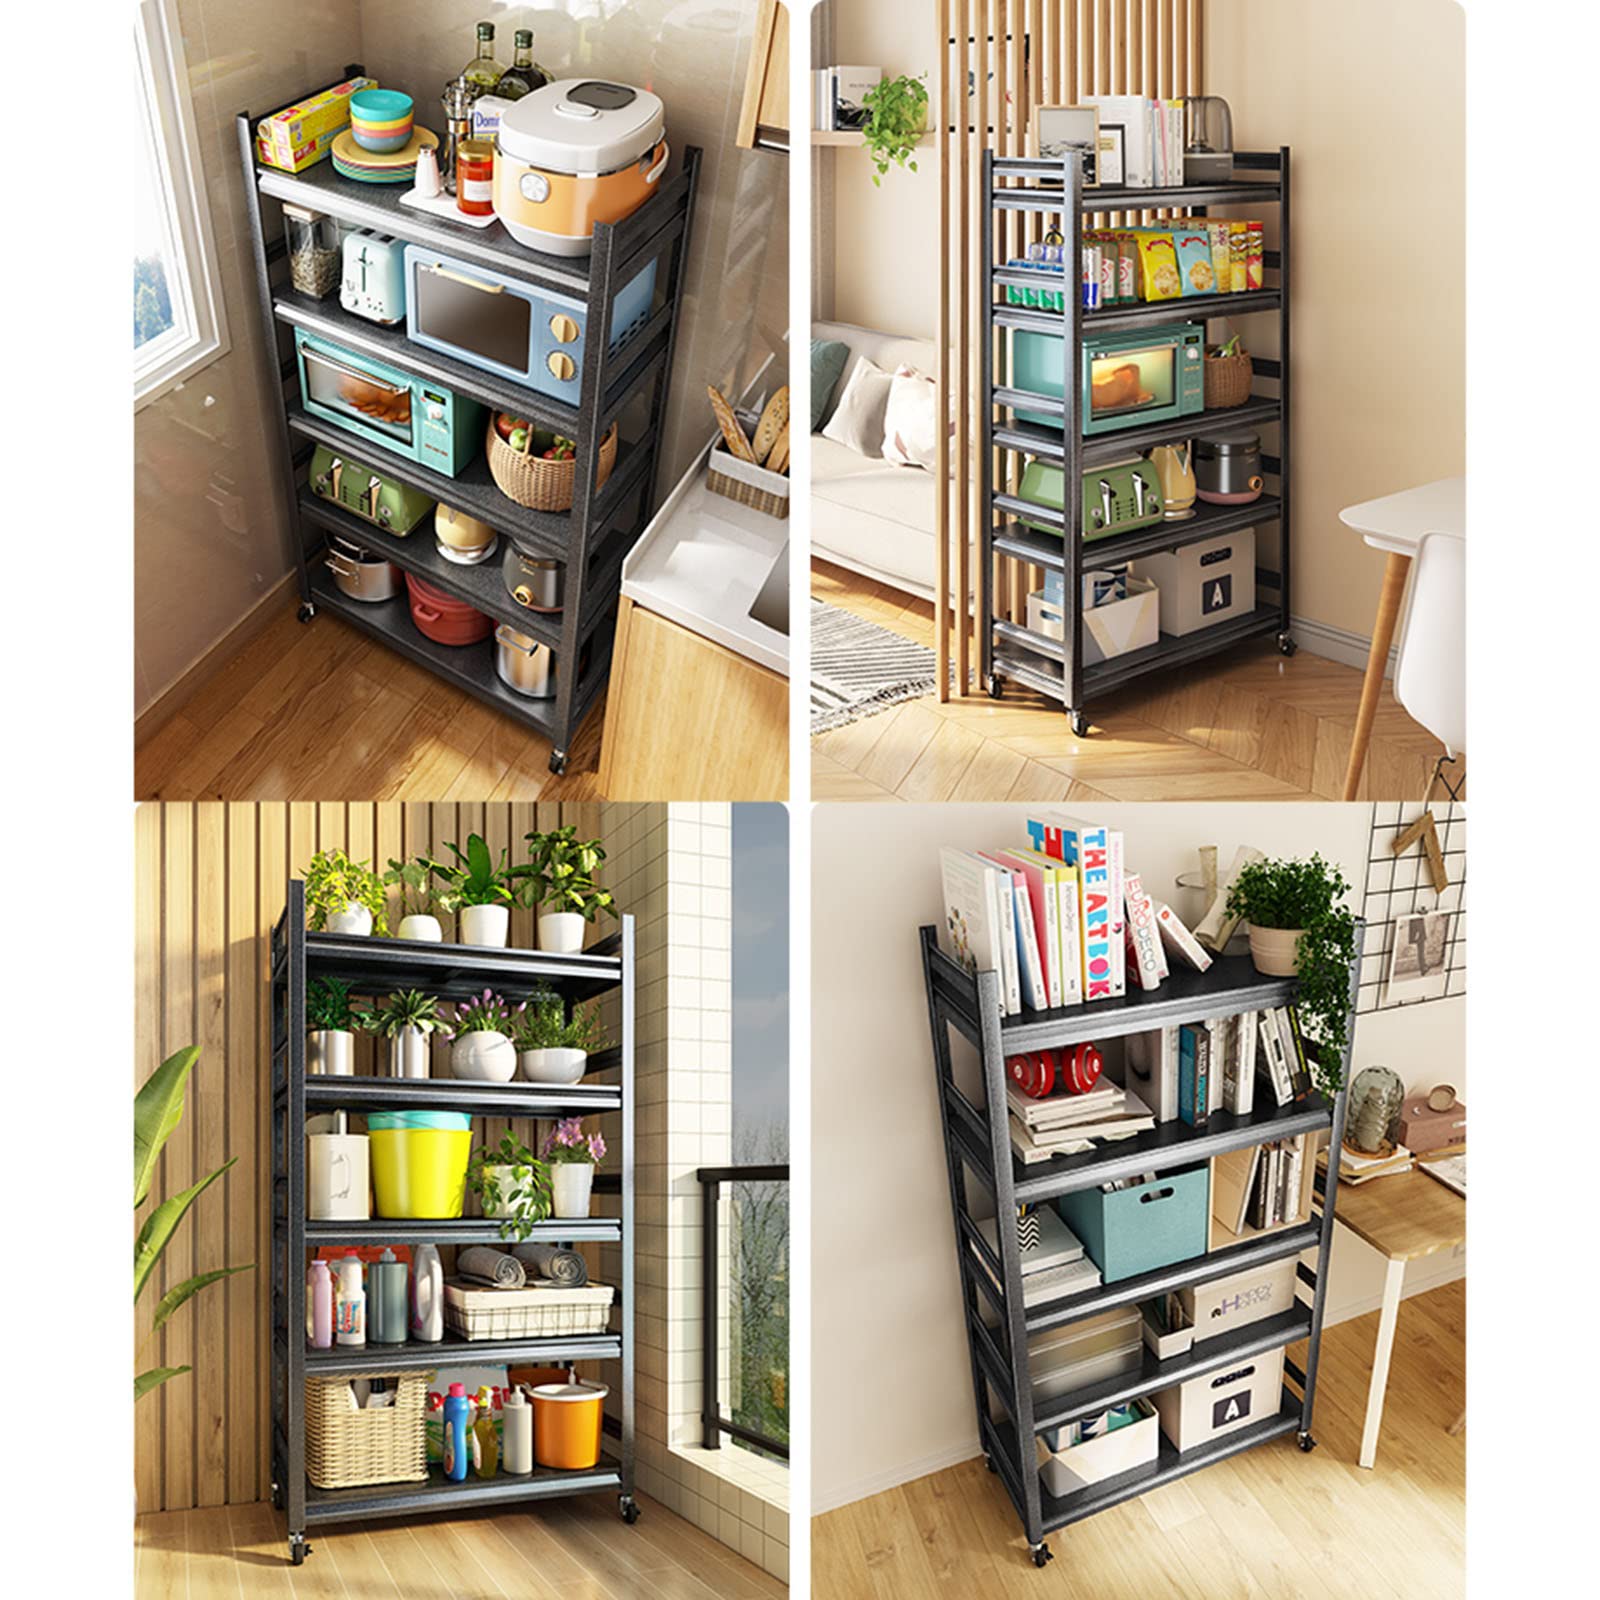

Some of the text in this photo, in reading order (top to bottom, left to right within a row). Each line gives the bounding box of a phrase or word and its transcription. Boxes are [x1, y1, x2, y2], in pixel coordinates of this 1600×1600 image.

[1027, 819, 1079, 867] THE
[1084, 829, 1107, 884] THE
[1224, 1399, 1240, 1421] A
